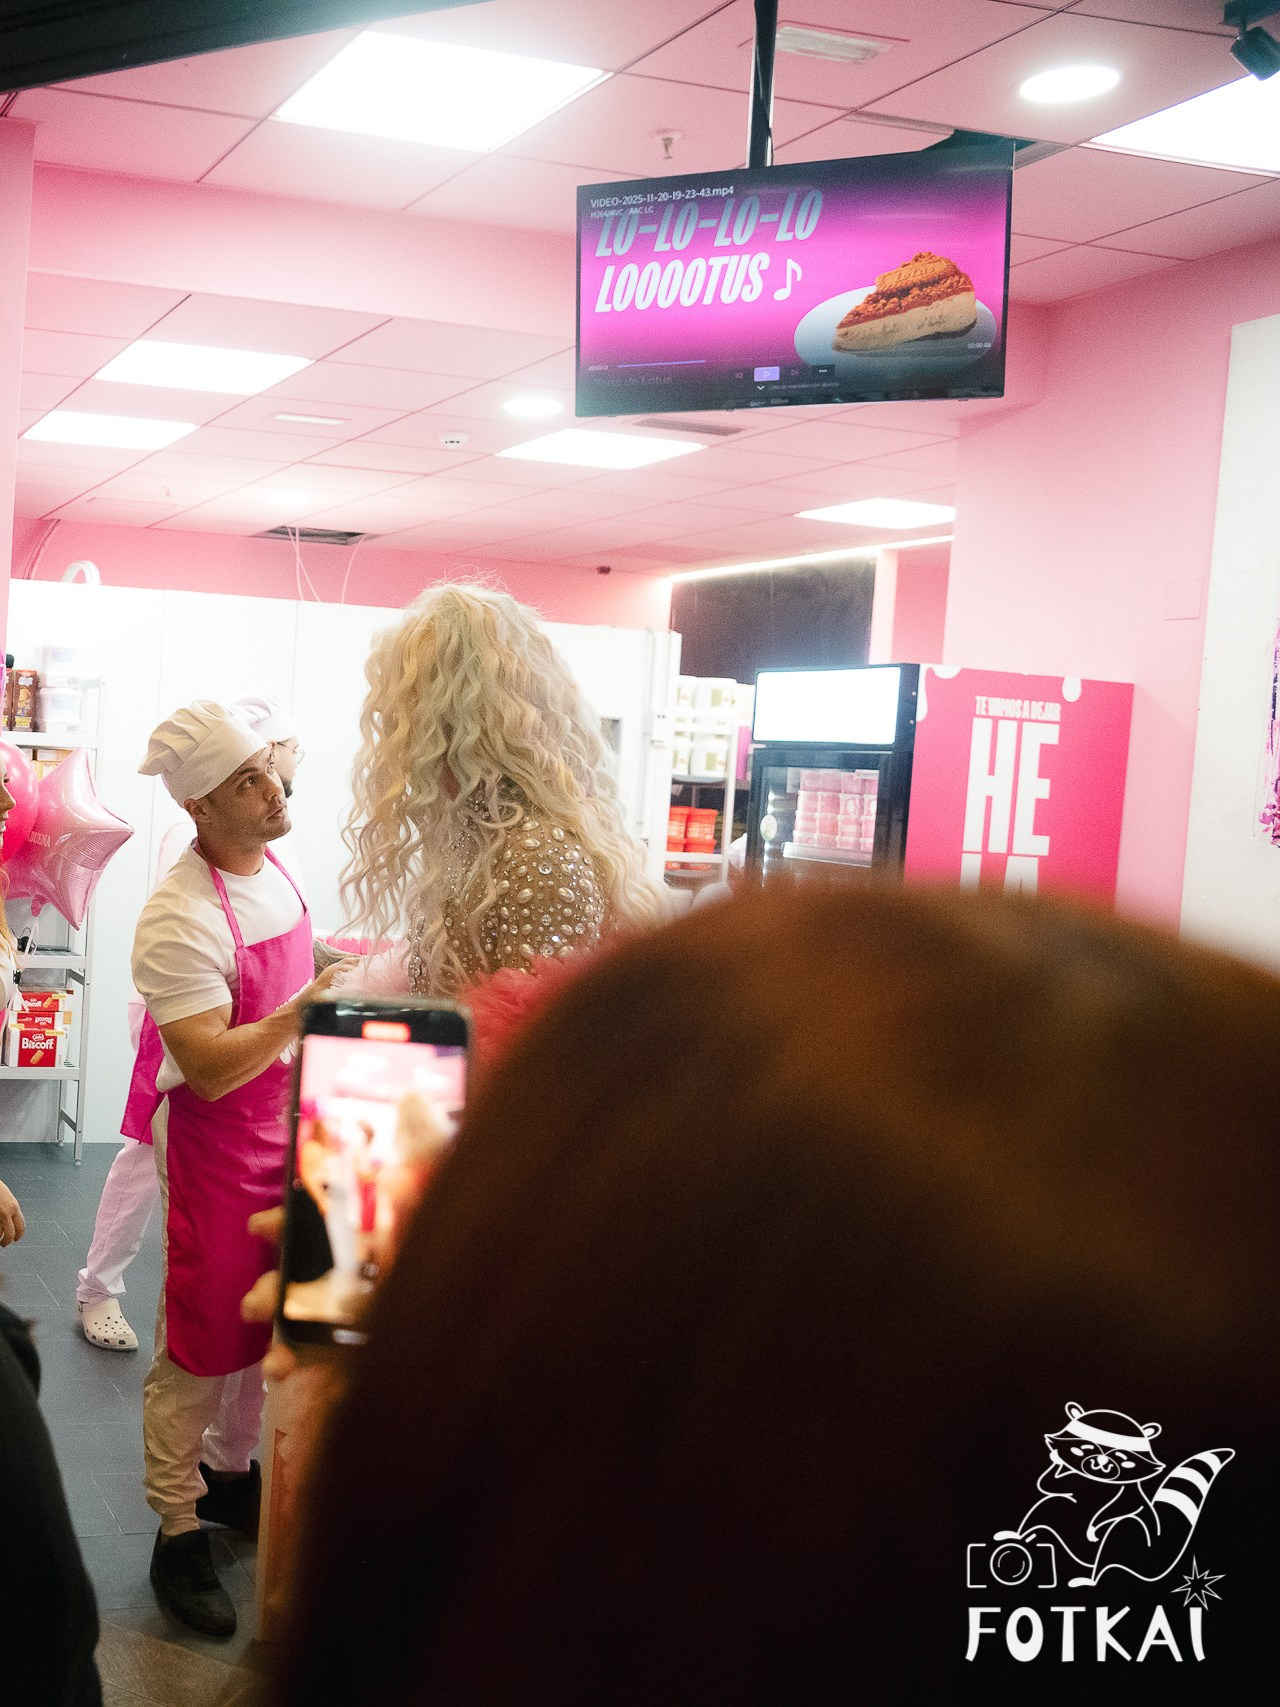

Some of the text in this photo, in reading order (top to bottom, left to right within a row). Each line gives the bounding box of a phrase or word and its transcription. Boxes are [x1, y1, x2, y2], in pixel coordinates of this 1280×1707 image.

[595, 189, 823, 257] LO-LO-LO-LO
[594, 252, 771, 313] LOOOOTUS
[975, 695, 988, 716] TE
[1022, 700, 1030, 719] A
[962, 717, 1060, 857] HE
